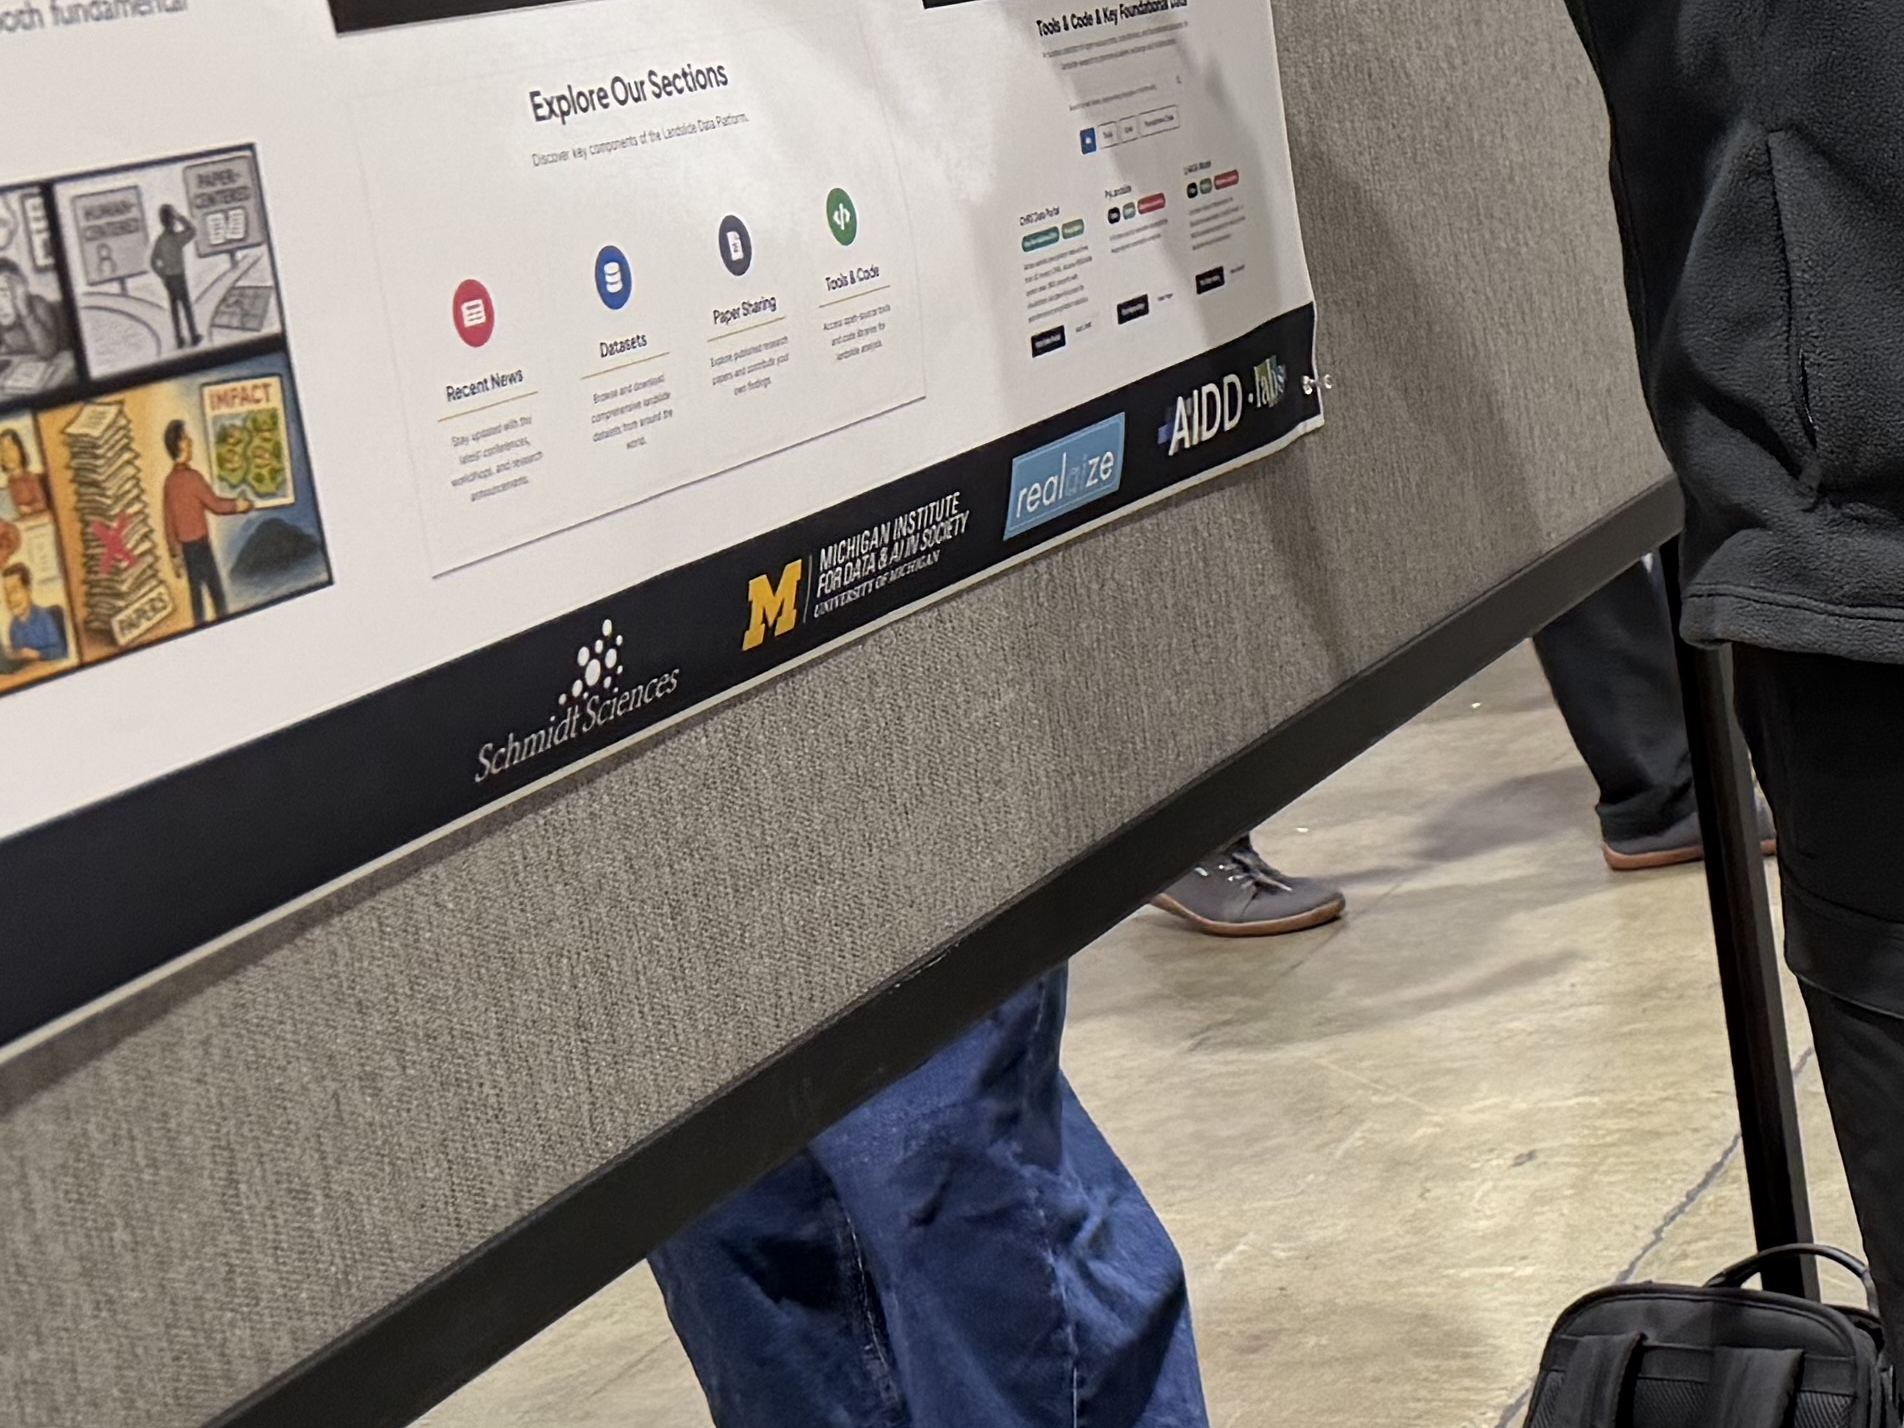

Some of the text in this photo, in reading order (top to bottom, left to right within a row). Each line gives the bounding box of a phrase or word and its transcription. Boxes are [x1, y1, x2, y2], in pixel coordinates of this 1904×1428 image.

[0, 0, 45, 31] oth
[1036, 15, 1061, 37] Tools
[1070, 10, 1094, 30] Code
[1102, 5, 1119, 26] Key
[529, 63, 728, 125] Explore Our Sections
[532, 147, 570, 167] Discover
[572, 146, 588, 161] key
[589, 135, 639, 156] components
[639, 132, 647, 145] of
[649, 130, 662, 143] the
[662, 120, 698, 140] Landslide
[697, 118, 716, 133] Data
[825, 272, 849, 292] Tools
[855, 264, 880, 282] Code
[712, 295, 777, 326] Paper Sharing
[599, 333, 648, 359] Datasets
[209, 383, 272, 412] IMPACT
[446, 369, 524, 403] Recent News
[1168, 373, 1243, 456] AIDD
[817, 510, 970, 597] FOR DATA & AI IN SOCIETY
[819, 491, 960, 571] MICHIGAN INSTITUTE
[742, 558, 802, 651] M
[813, 550, 941, 618] UNIVERSITY OF MICHIGAN
[475, 668, 680, 782] Schmidt Sciences
